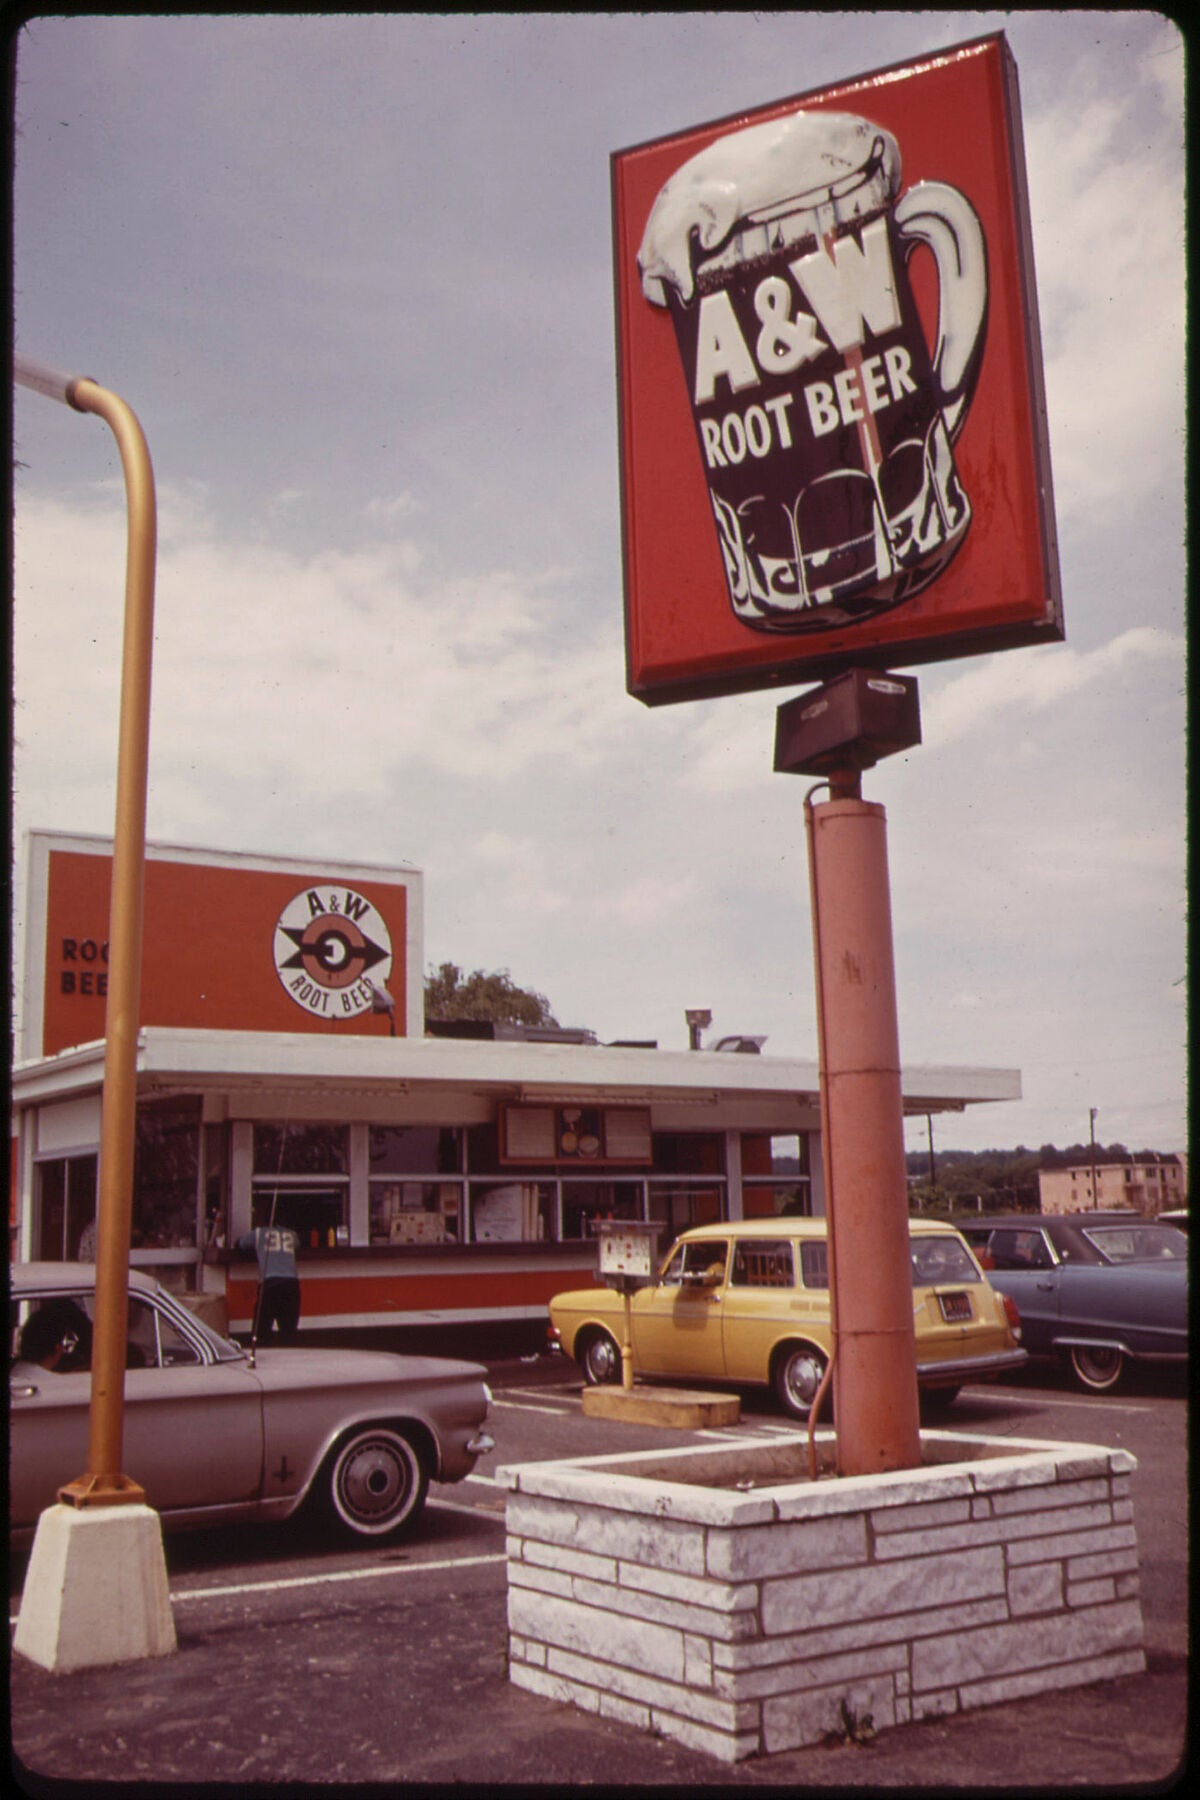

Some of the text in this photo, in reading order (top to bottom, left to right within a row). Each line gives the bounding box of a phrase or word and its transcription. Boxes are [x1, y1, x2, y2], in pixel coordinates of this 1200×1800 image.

[695, 215, 902, 405] A&W
[700, 346, 917, 468] ROOT BEER
[61, 970, 108, 996] BEE
[290, 975, 330, 1012] ROOT
[264, 1230, 295, 1254] 32
